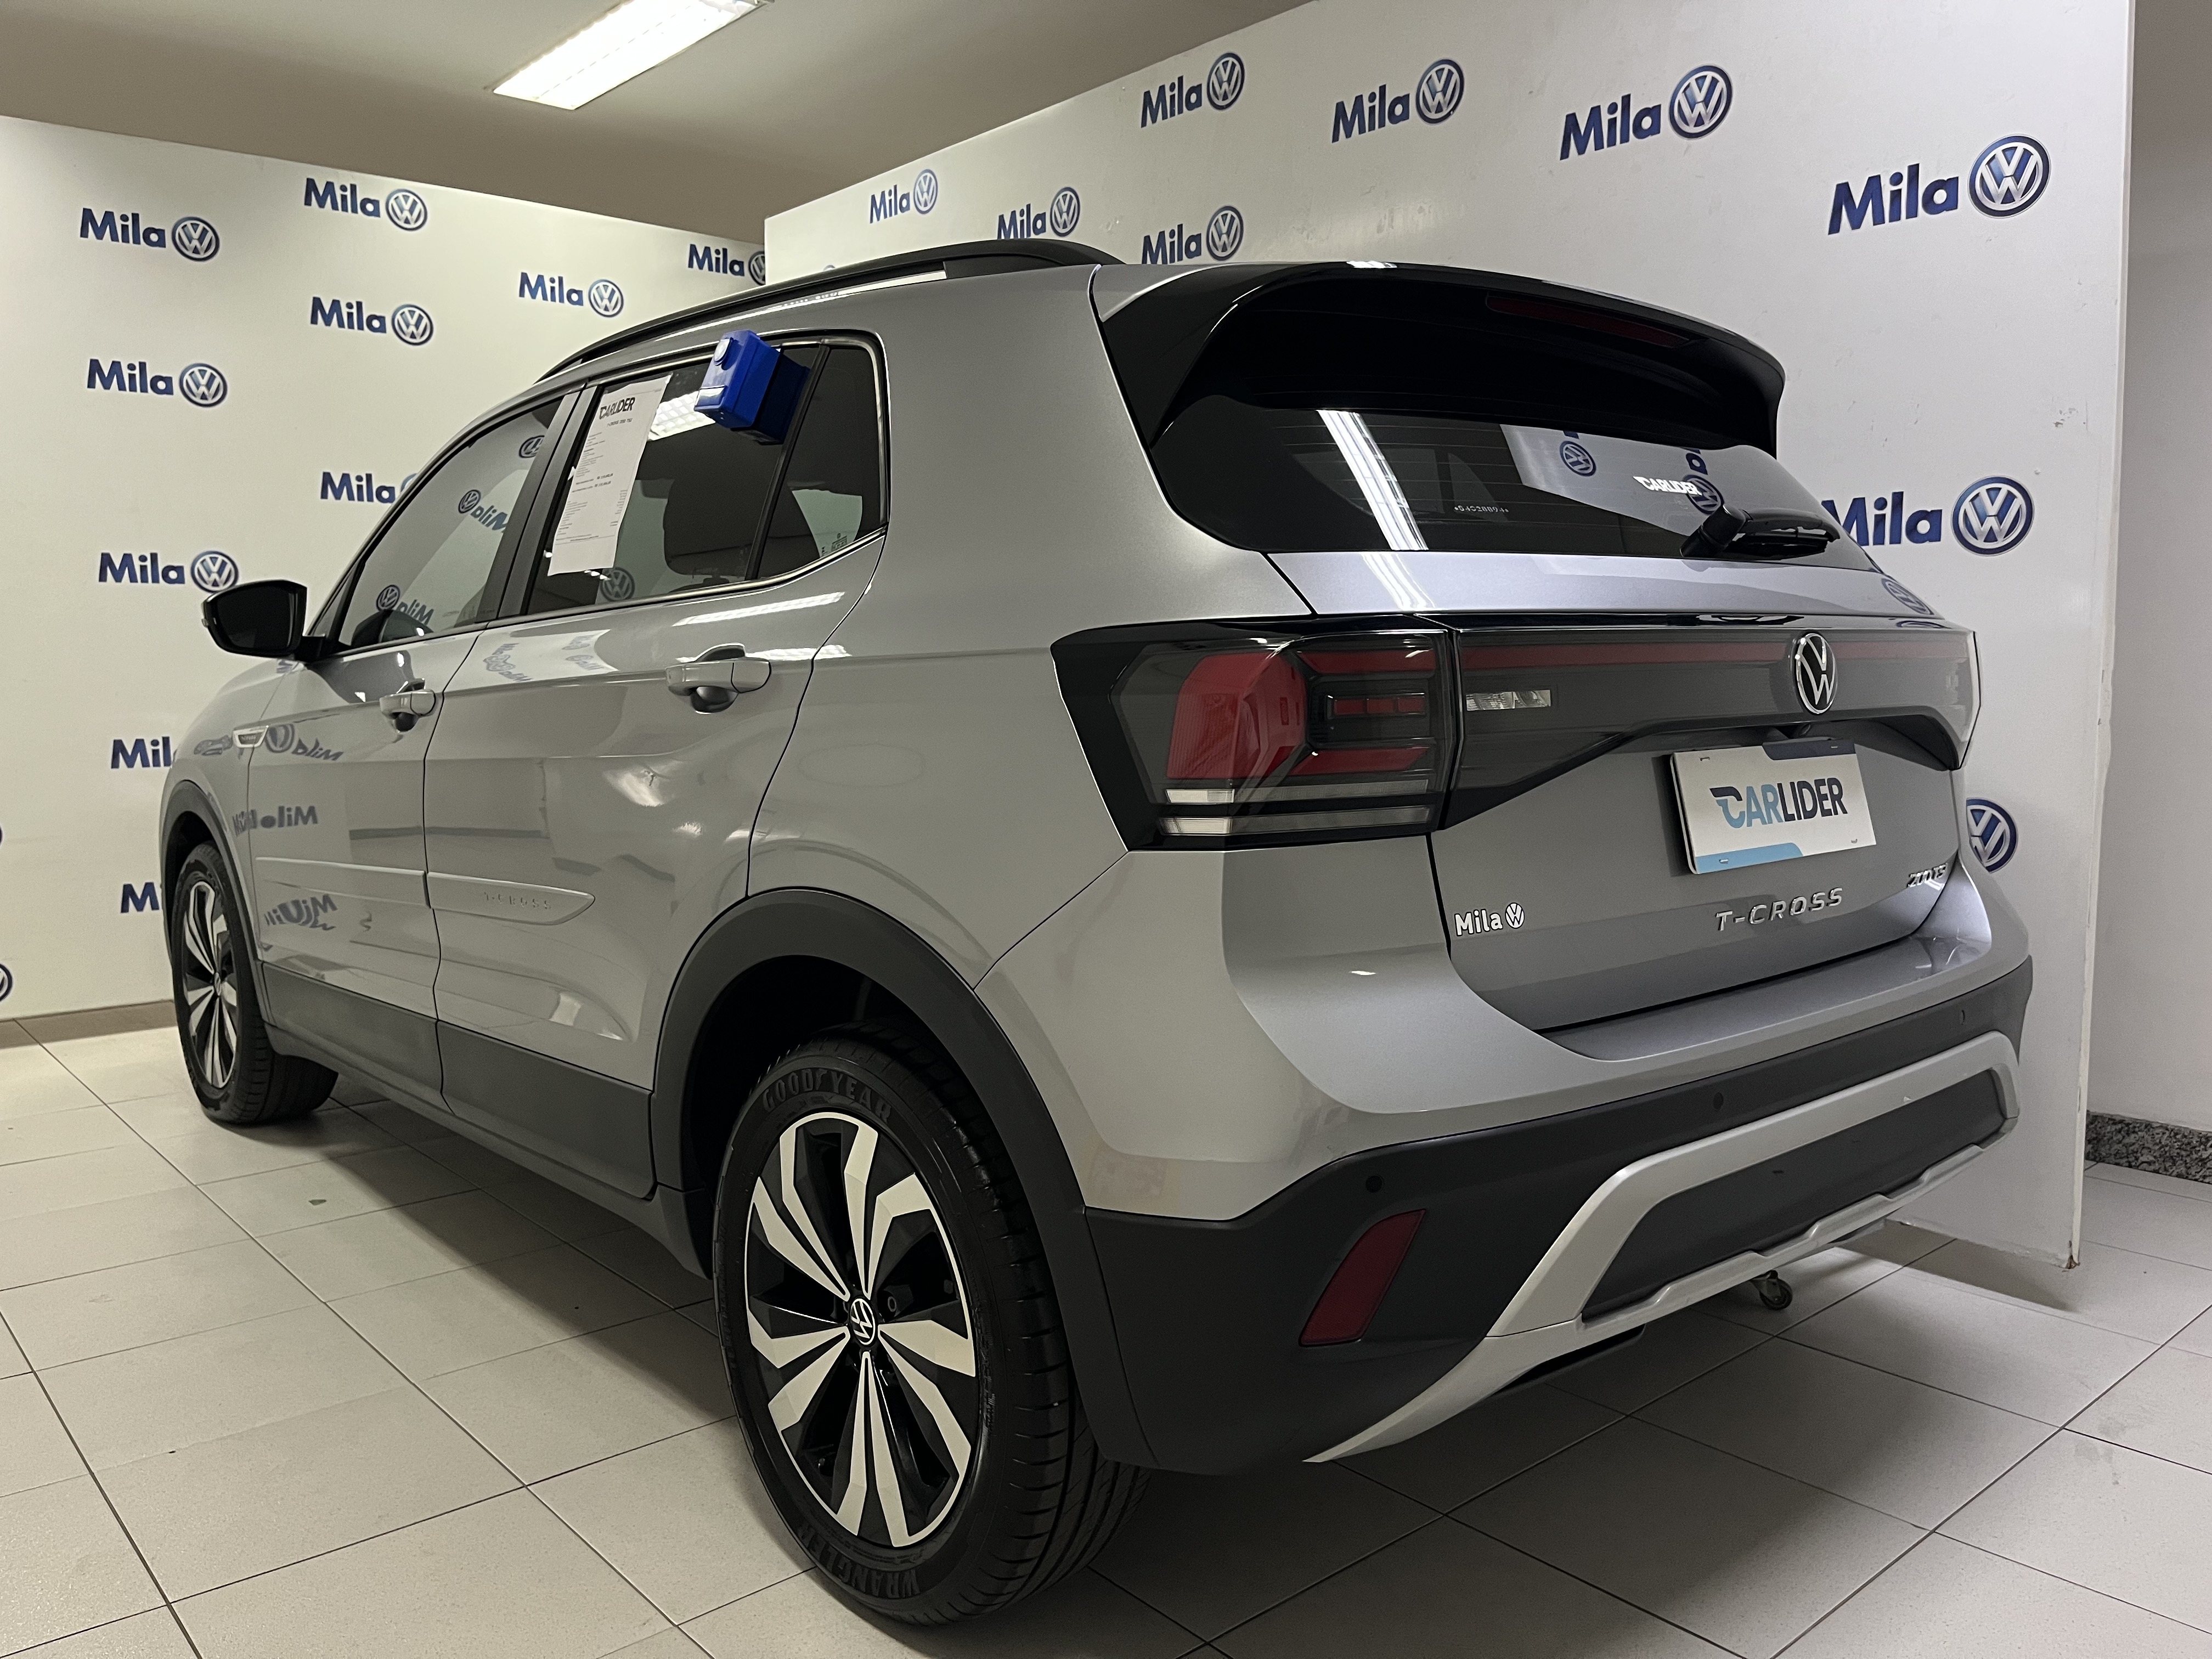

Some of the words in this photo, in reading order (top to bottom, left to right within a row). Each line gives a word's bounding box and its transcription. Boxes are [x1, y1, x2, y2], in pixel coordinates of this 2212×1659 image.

[1141, 75, 1202, 128] Mila
[1332, 84, 1409, 143] Mila
[1560, 94, 1661, 160] Mila
[304, 178, 380, 218] Mila
[870, 185, 910, 223] Mila
[1828, 163, 1959, 235] Mila
[80, 208, 166, 248] Mila
[997, 204, 1046, 240] Mila
[688, 244, 744, 276] Mila
[1142, 224, 1201, 264] Mila
[519, 272, 583, 306] Mila
[311, 297, 386, 334] Mila
[87, 359, 173, 395] Mila
[320, 472, 395, 503] Mila
[1633, 476, 1702, 496] CARLIDER
[1821, 492, 1942, 546] Mila
[99, 552, 185, 584] Mila
[111, 736, 178, 769] Mil
[1709, 777, 1848, 828] CARLIDER
[1454, 909, 1503, 936] Mila
[1715, 887, 1843, 932] T-CROSS
